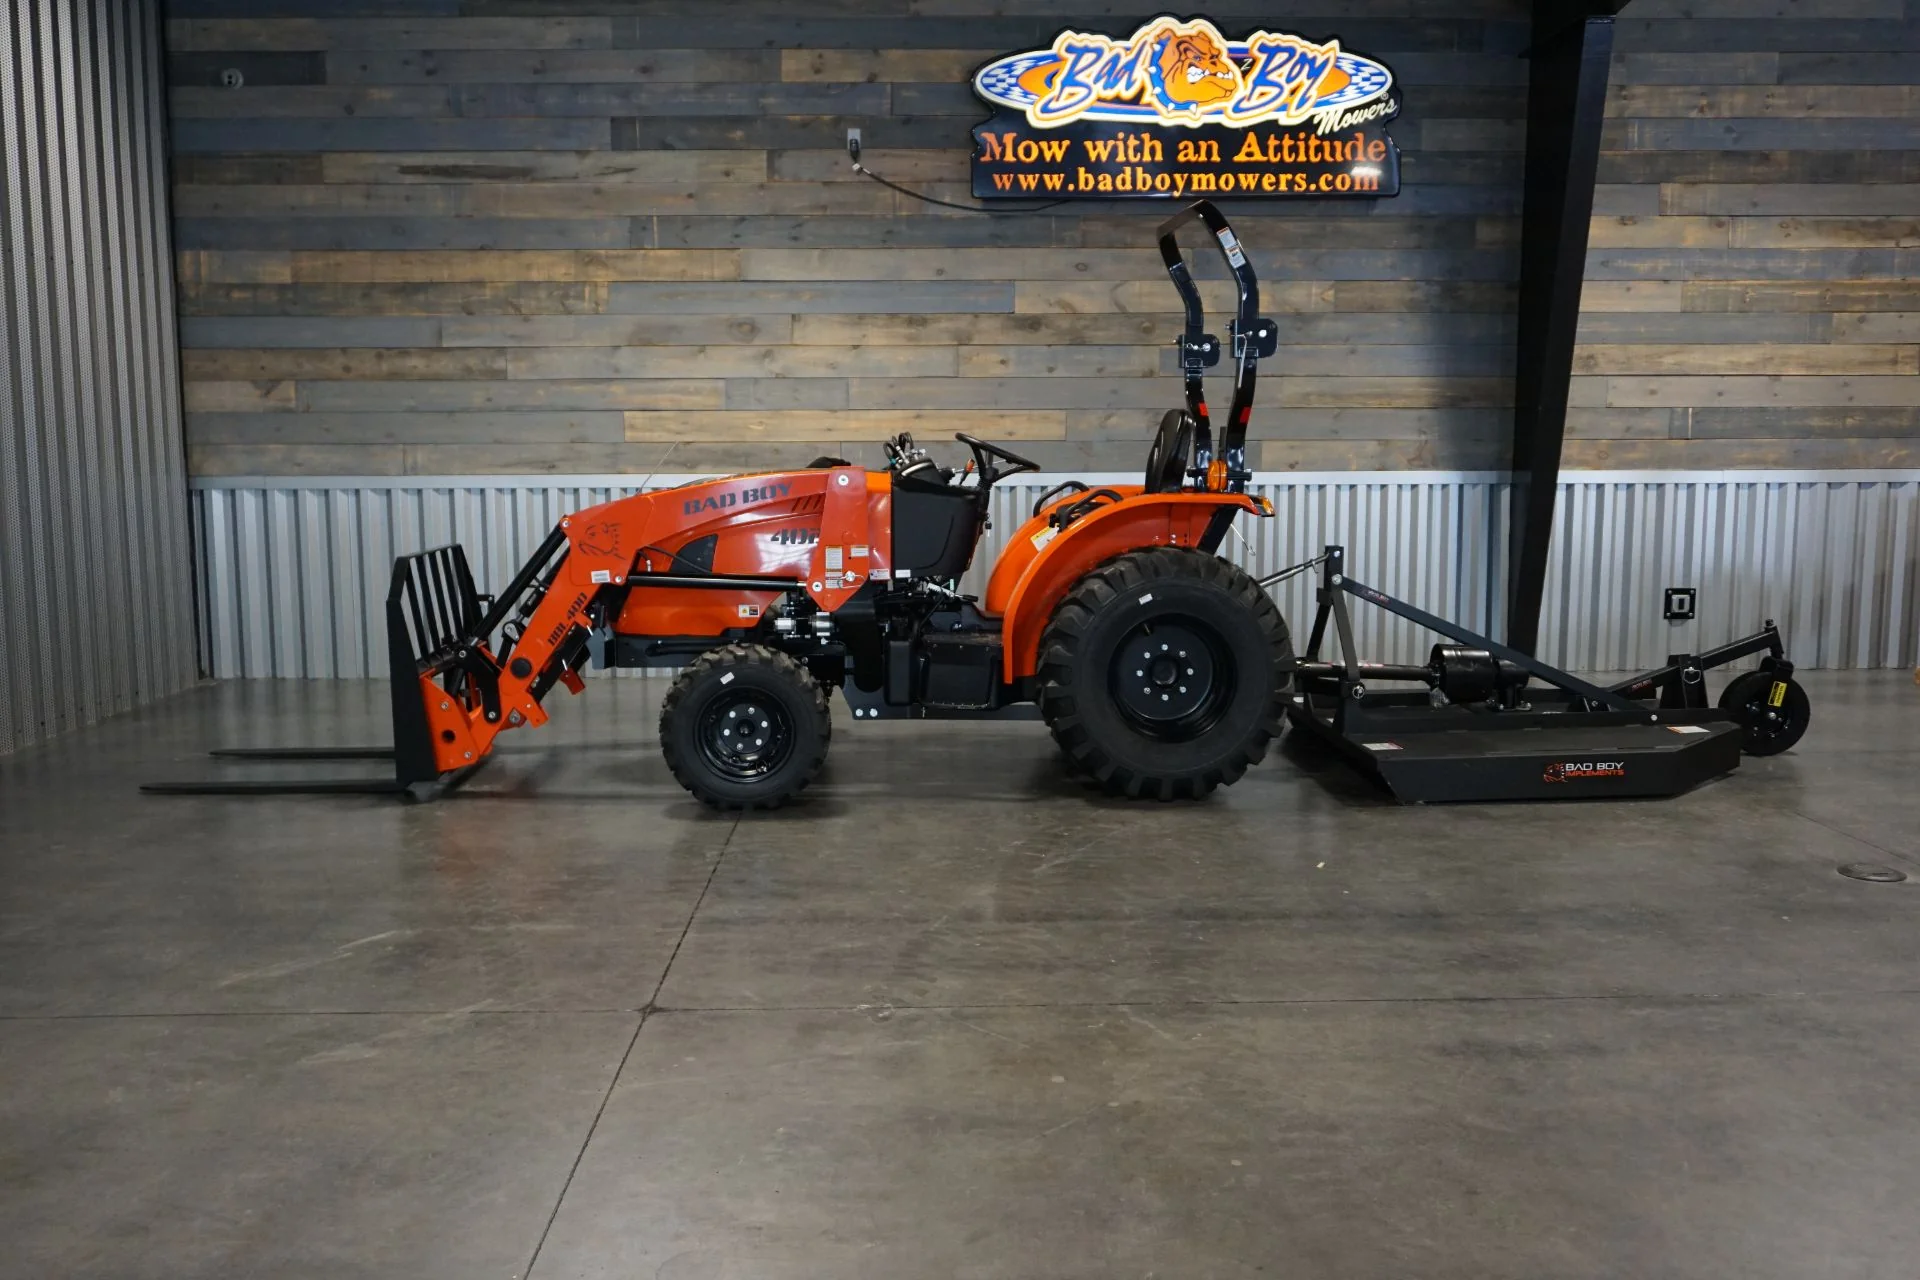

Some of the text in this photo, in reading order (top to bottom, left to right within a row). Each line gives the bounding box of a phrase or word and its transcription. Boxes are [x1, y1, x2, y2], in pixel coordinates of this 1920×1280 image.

[1040, 38, 1331, 115] Bad Boy
[1313, 98, 1398, 136] Mowers
[980, 132, 1387, 163] Mow with an Attitude
[992, 167, 1380, 198] www.badboymowers.com
[683, 483, 793, 515] BAD BOY
[1565, 762, 1624, 771] BAD BOY
